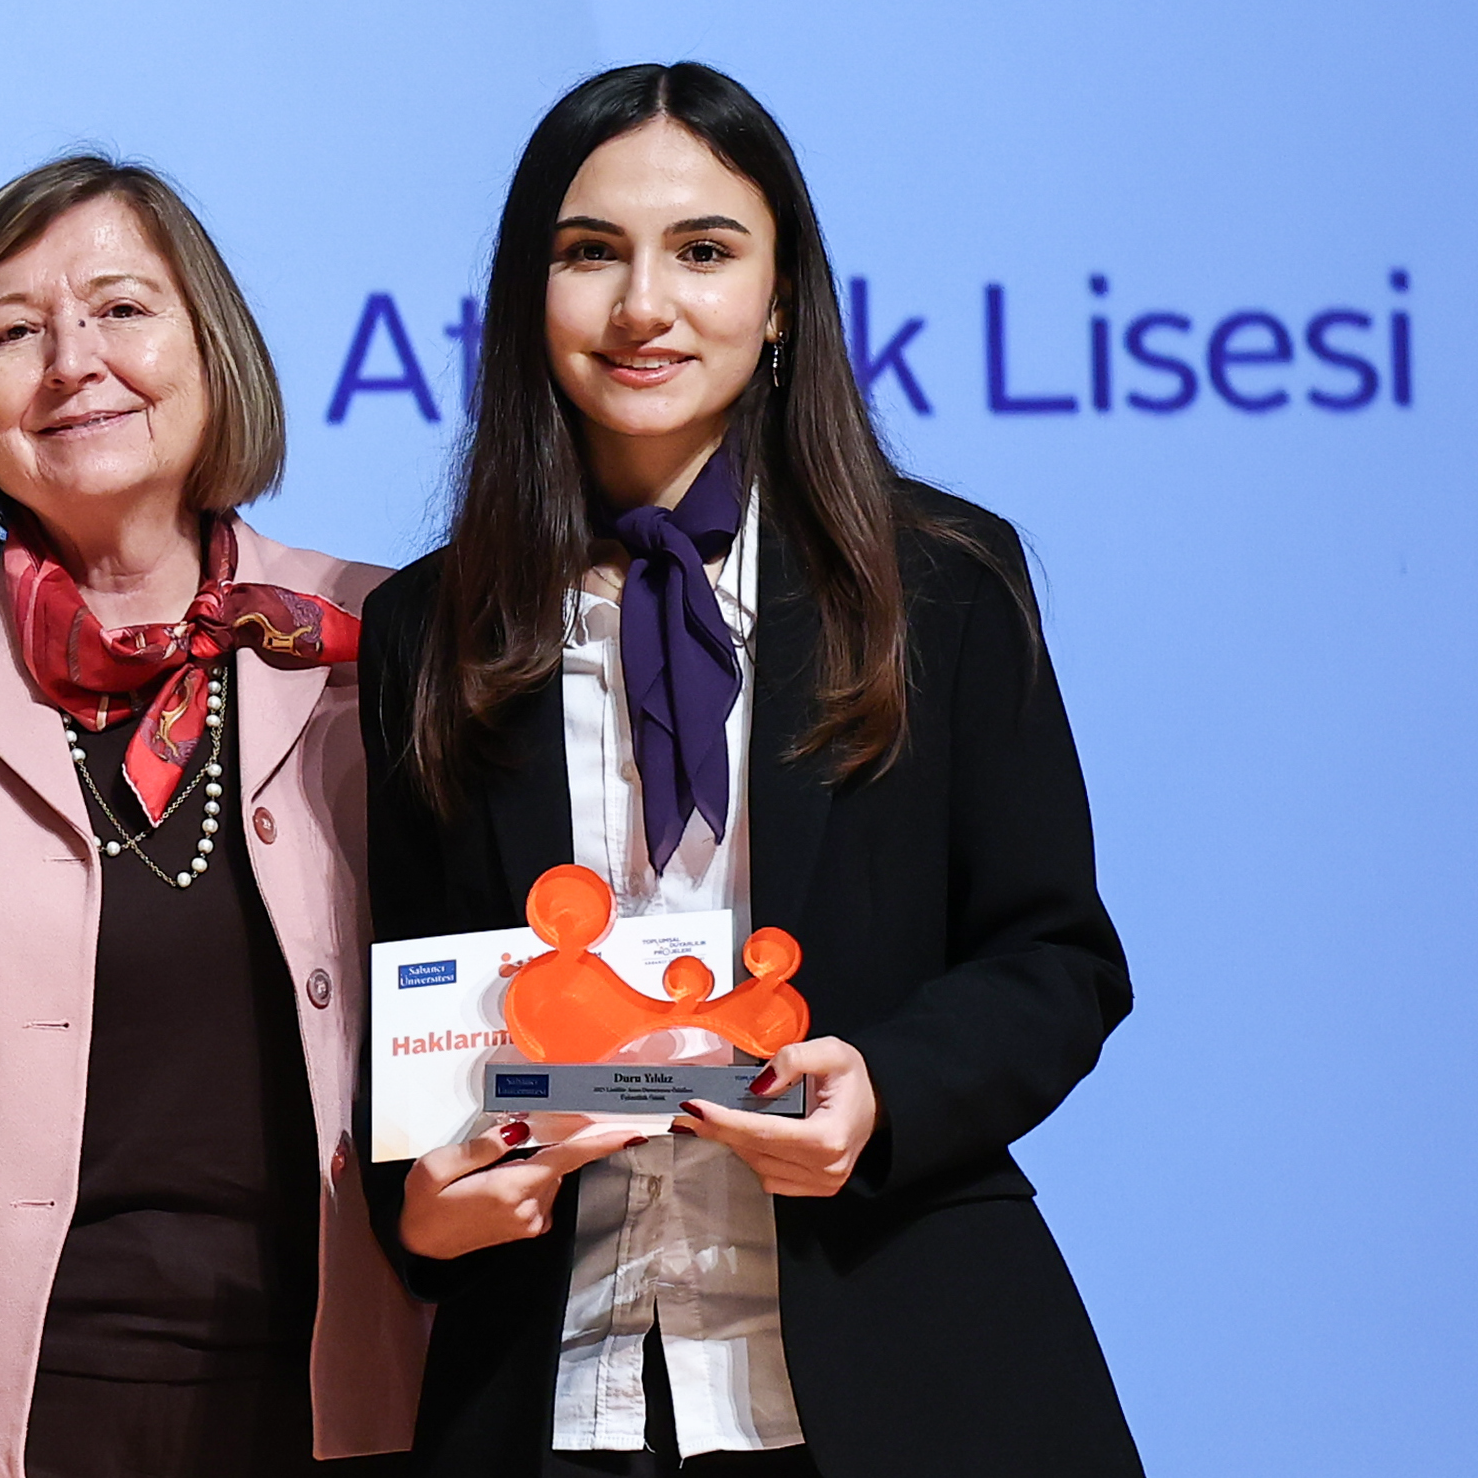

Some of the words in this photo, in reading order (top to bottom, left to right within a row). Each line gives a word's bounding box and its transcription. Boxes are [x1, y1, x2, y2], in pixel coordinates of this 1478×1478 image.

[983, 268, 1414, 416] Lisesi
[392, 1029, 514, 1056] Haklarım
[614, 1073, 642, 1084] Duru
